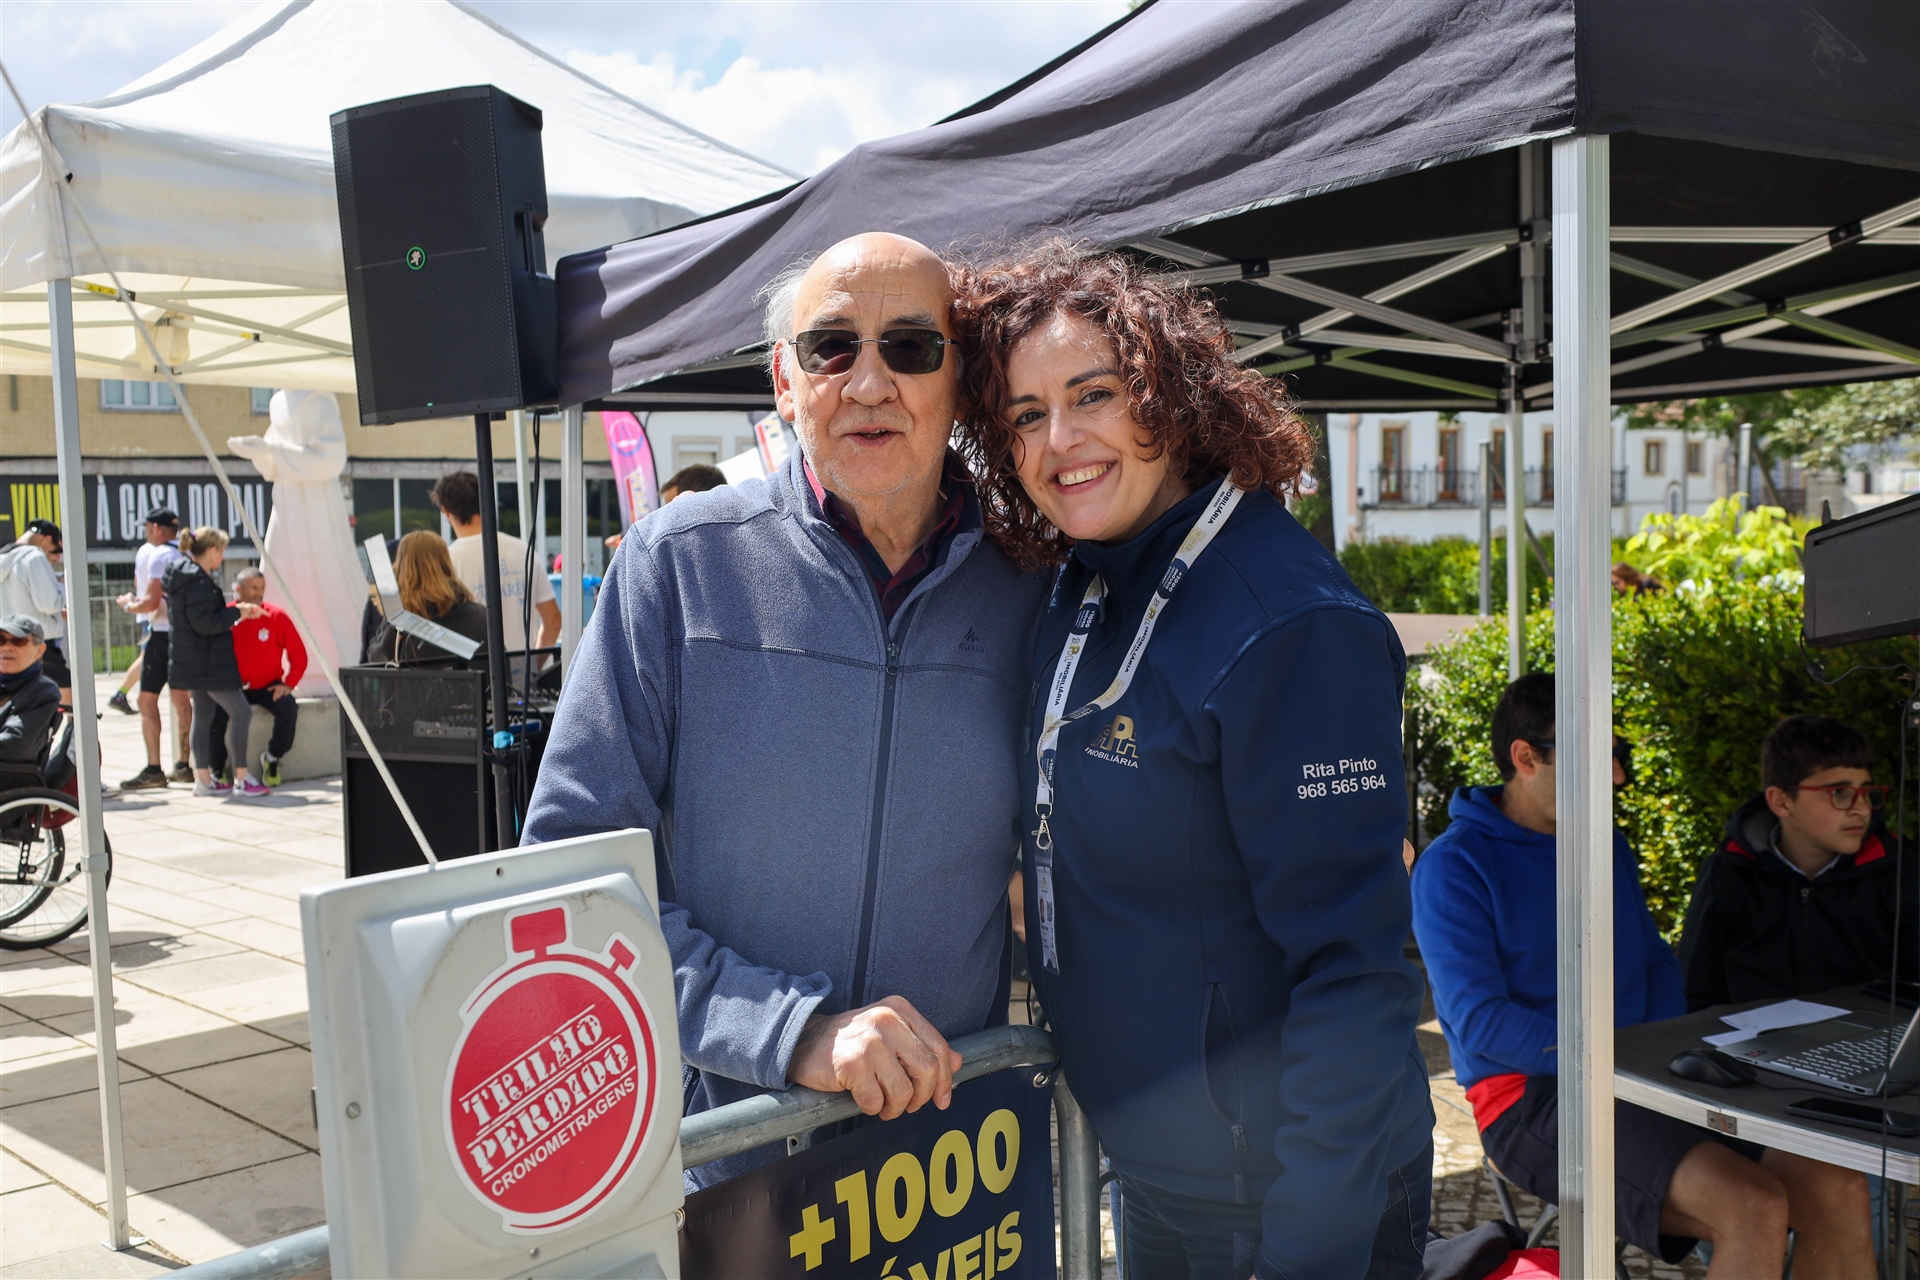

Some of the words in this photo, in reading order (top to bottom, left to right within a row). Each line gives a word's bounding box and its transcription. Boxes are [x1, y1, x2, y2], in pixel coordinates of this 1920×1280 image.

[97, 474, 112, 541] À
[187, 483, 220, 533] DO
[1207, 485, 1236, 524] IMOBILIÁRIA
[1054, 661, 1071, 706] IMOBILIÁRIA
[1084, 747, 1139, 768] IMOBILIÁRIA
[1302, 763, 1336, 779] Rita
[1339, 757, 1377, 774] Pinto
[1297, 782, 1327, 799] 968
[1331, 777, 1358, 795] 565
[1361, 774, 1386, 790] 964
[461, 1014, 602, 1126] TRILHO
[469, 1043, 629, 1177] PERDIDO
[490, 1077, 636, 1197] CRONOMETRAGENS
[790, 1109, 1020, 1272] +1000
